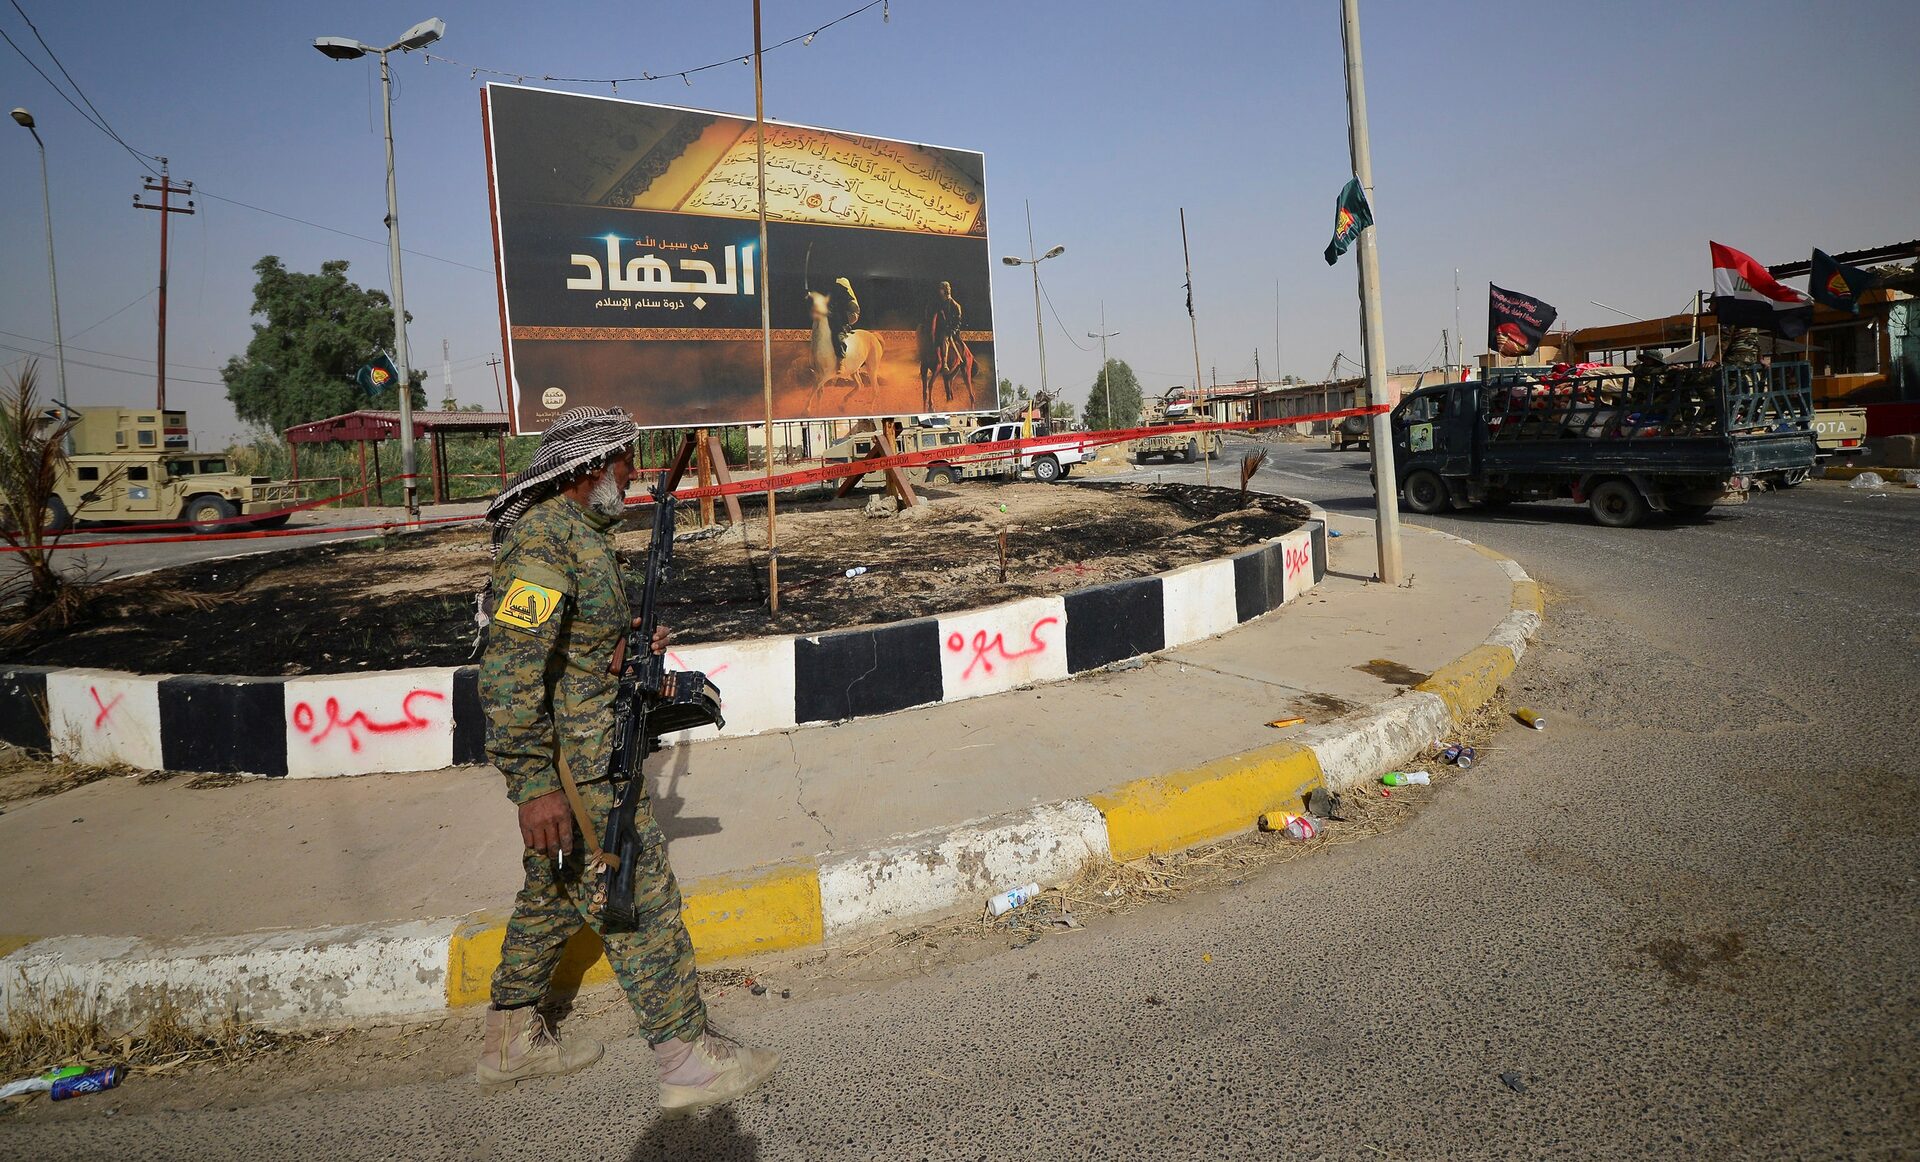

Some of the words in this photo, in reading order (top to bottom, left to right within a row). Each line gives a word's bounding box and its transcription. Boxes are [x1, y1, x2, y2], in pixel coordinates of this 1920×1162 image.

[635, 236, 656, 248] الله
[659, 238, 688, 250] سبيل
[690, 242, 709, 253] في
[567, 235, 755, 310] الجهاد
[595, 297, 632, 311] الإسلام
[635, 298, 661, 309] سنام
[663, 297, 685, 310] ذروة
[1809, 421, 1847, 433] OTA
